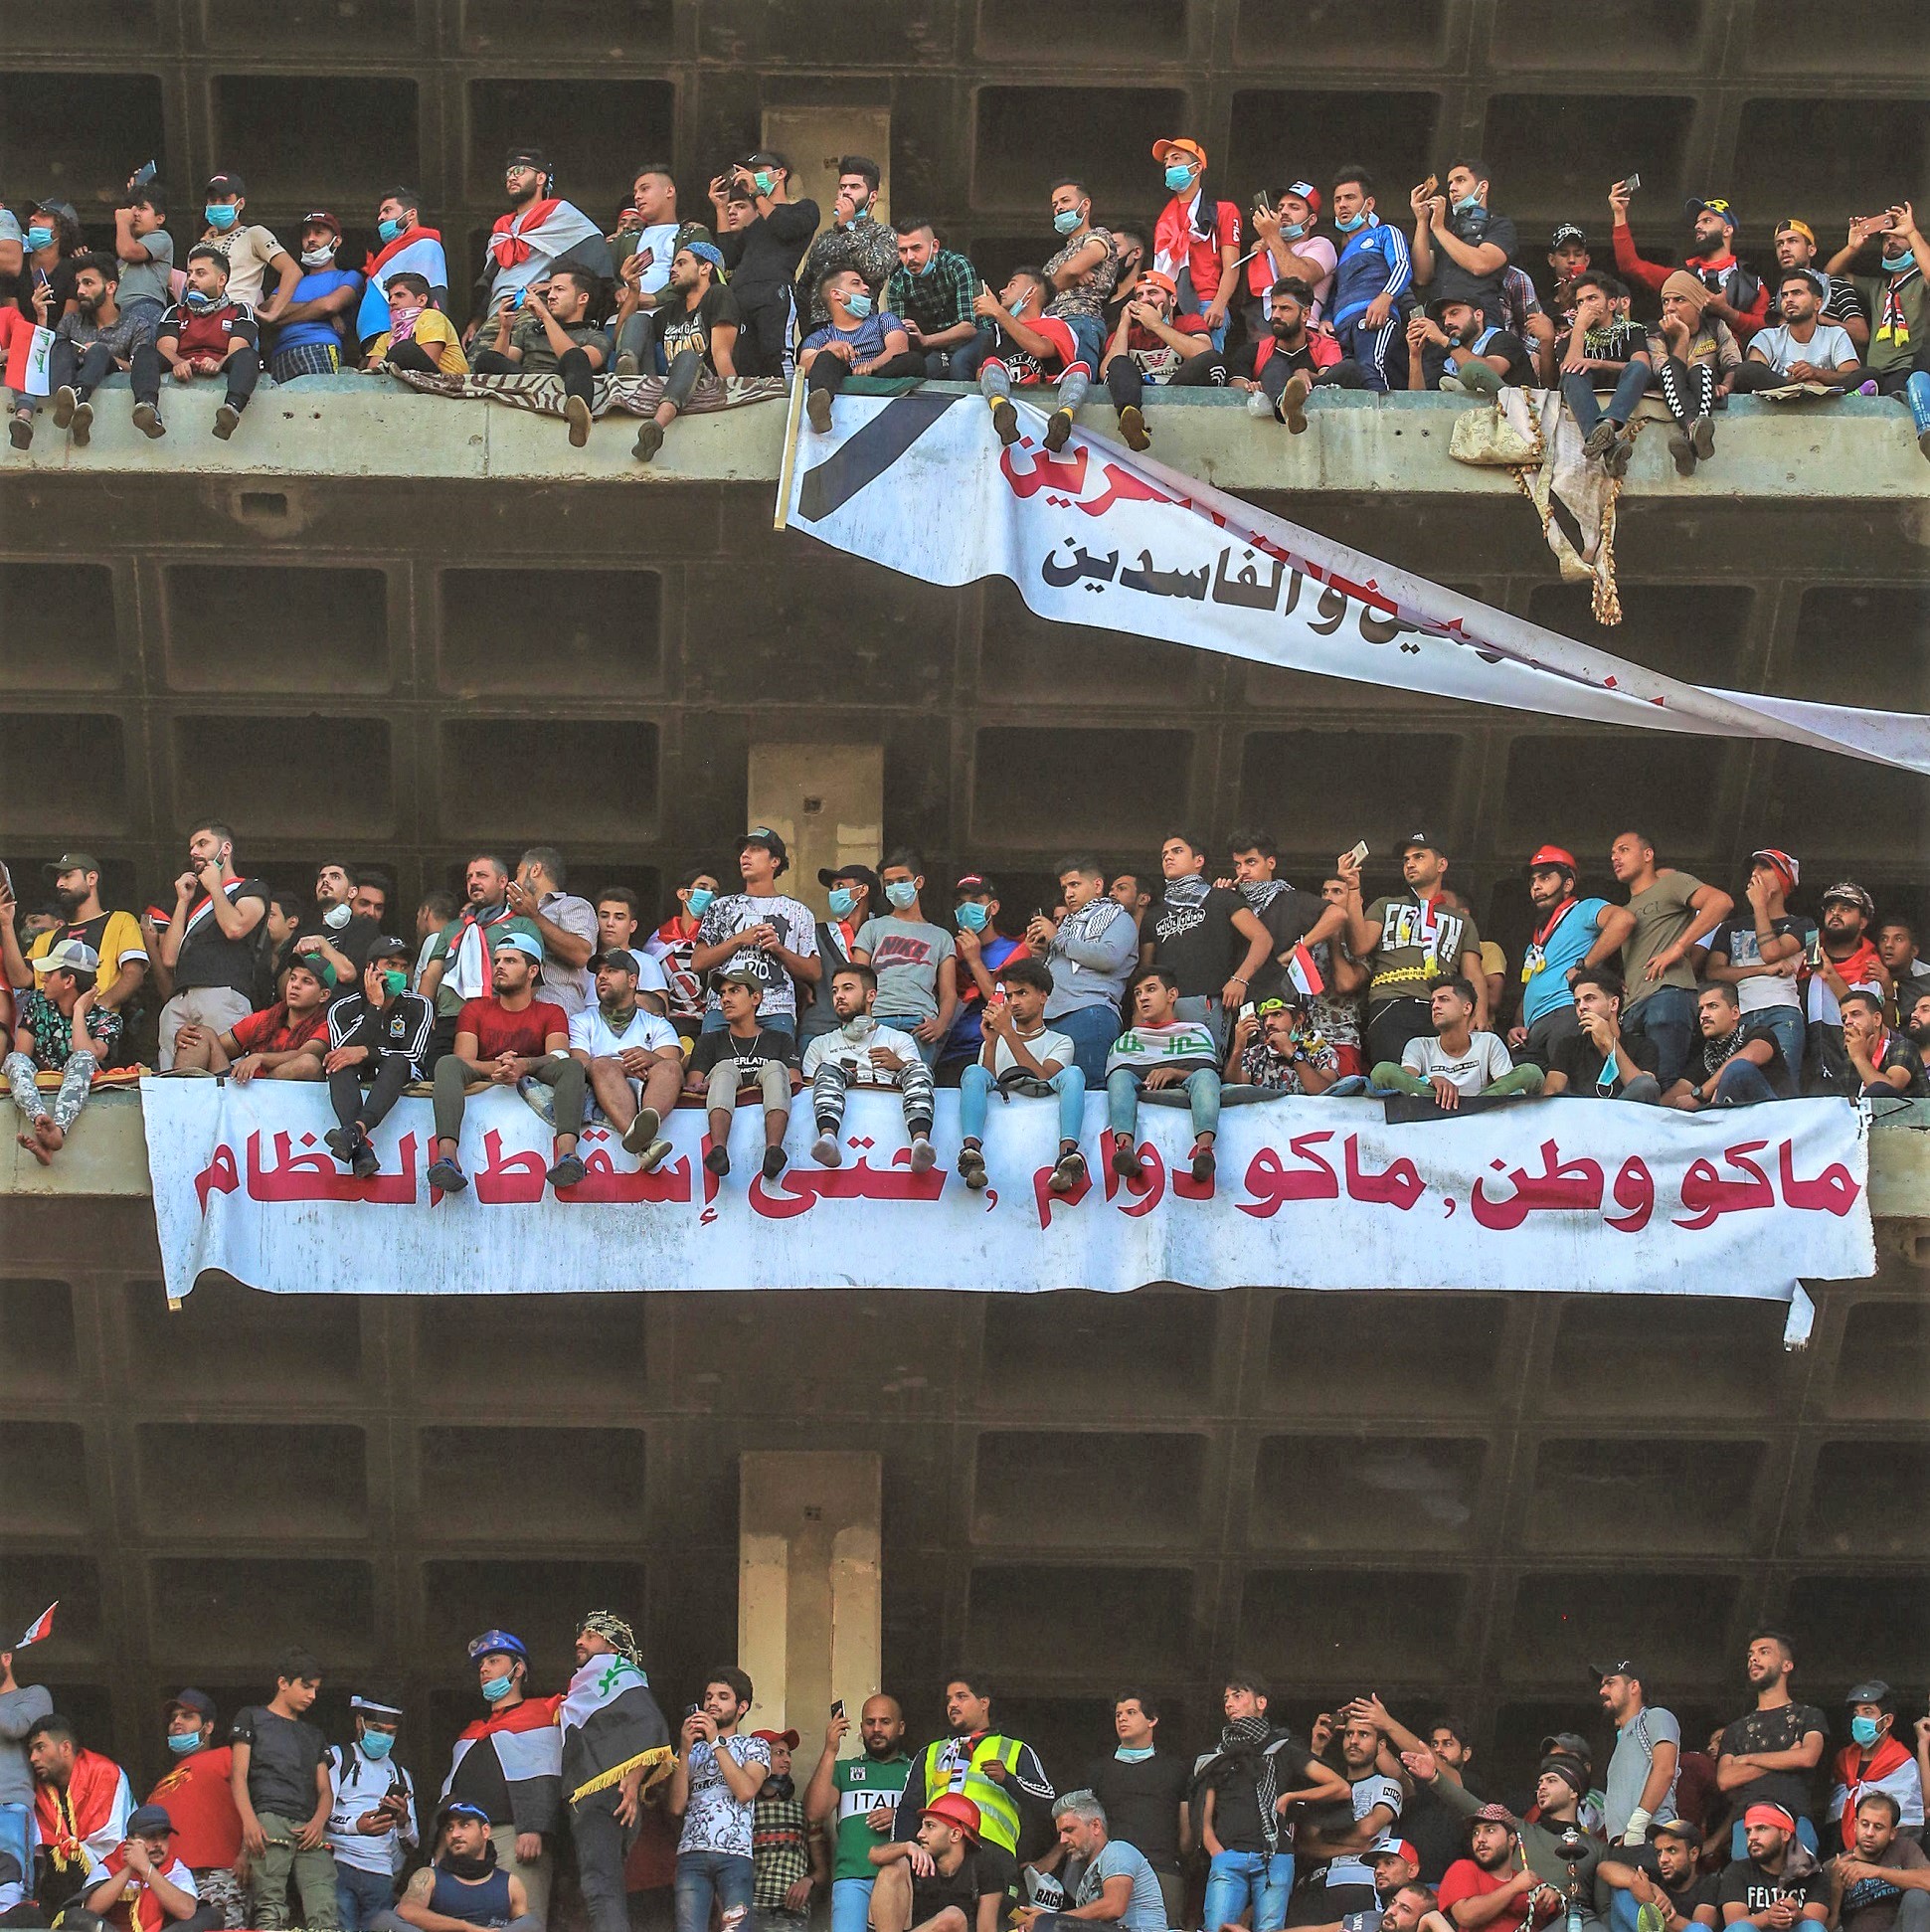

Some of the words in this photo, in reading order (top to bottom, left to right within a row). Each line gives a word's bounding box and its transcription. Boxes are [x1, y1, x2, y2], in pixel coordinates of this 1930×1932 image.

[1041, 535, 1348, 636] والفاسدين
[748, 1135, 949, 1221] حتى
[1234, 1130, 1428, 1218] ماكو
[1670, 1139, 1862, 1231] ماكو
